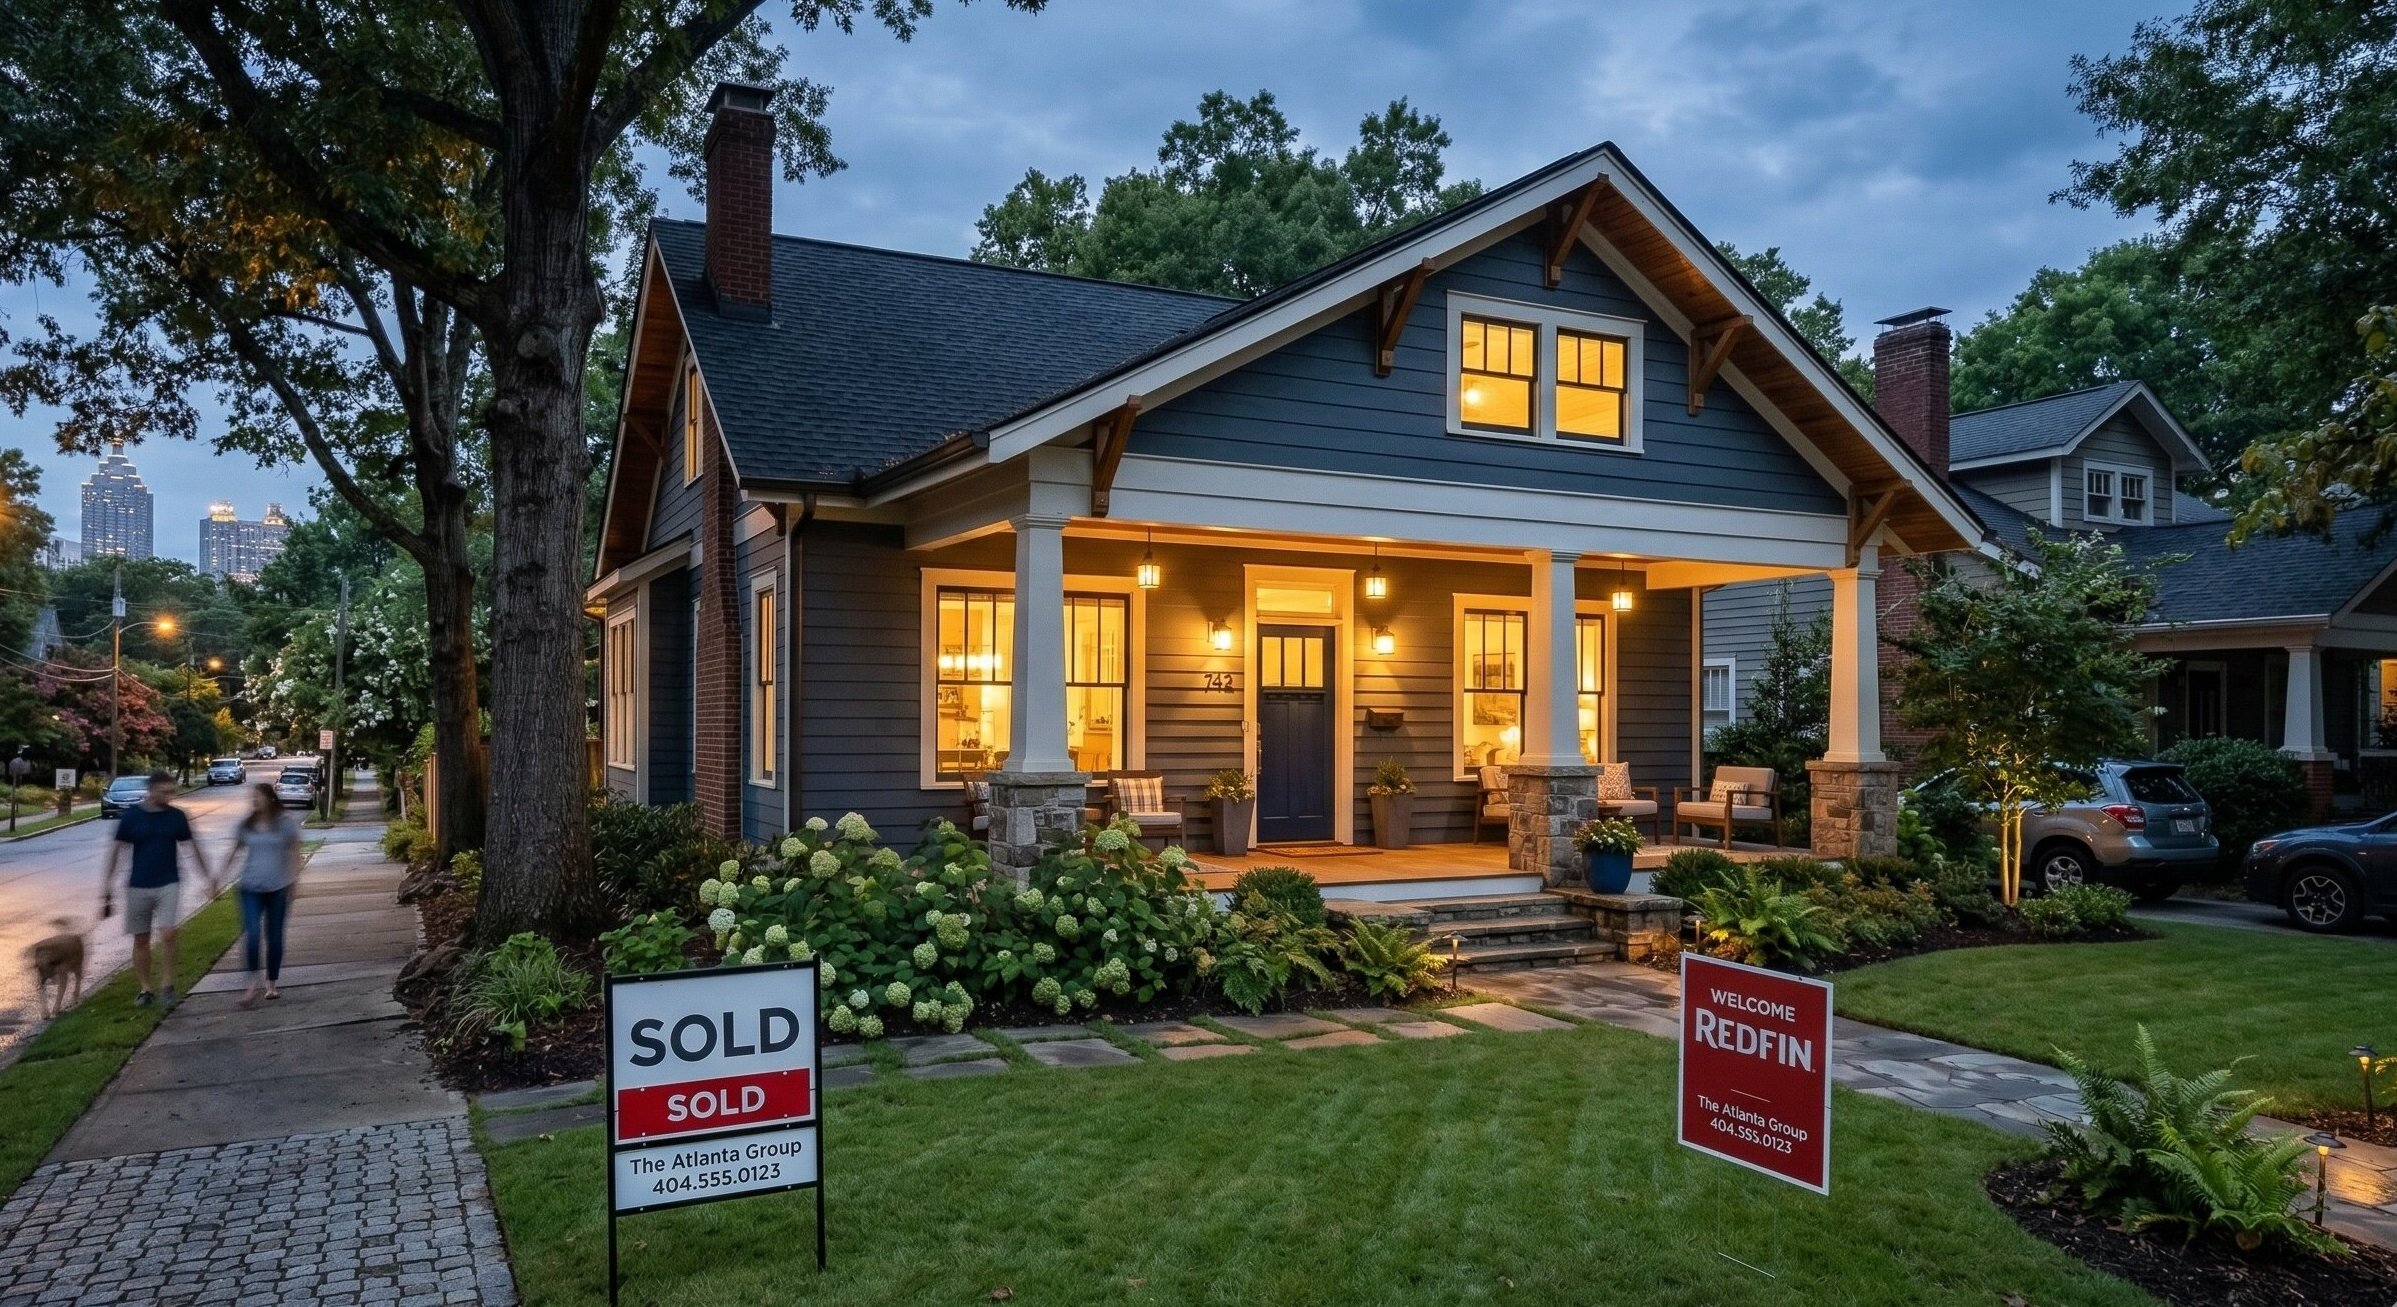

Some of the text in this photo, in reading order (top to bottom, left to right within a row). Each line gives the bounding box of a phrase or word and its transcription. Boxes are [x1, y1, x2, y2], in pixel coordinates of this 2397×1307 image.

[1204, 673, 1234, 693] 742
[1711, 988, 1796, 1023] WELCOME
[629, 1007, 800, 1067] SOLD
[667, 1085, 766, 1122] SOLD
[1697, 1094, 1808, 1142] The Atlanta Group
[630, 1140, 802, 1175] The Atlanta Group
[652, 1163, 781, 1195] 404.555.0123
